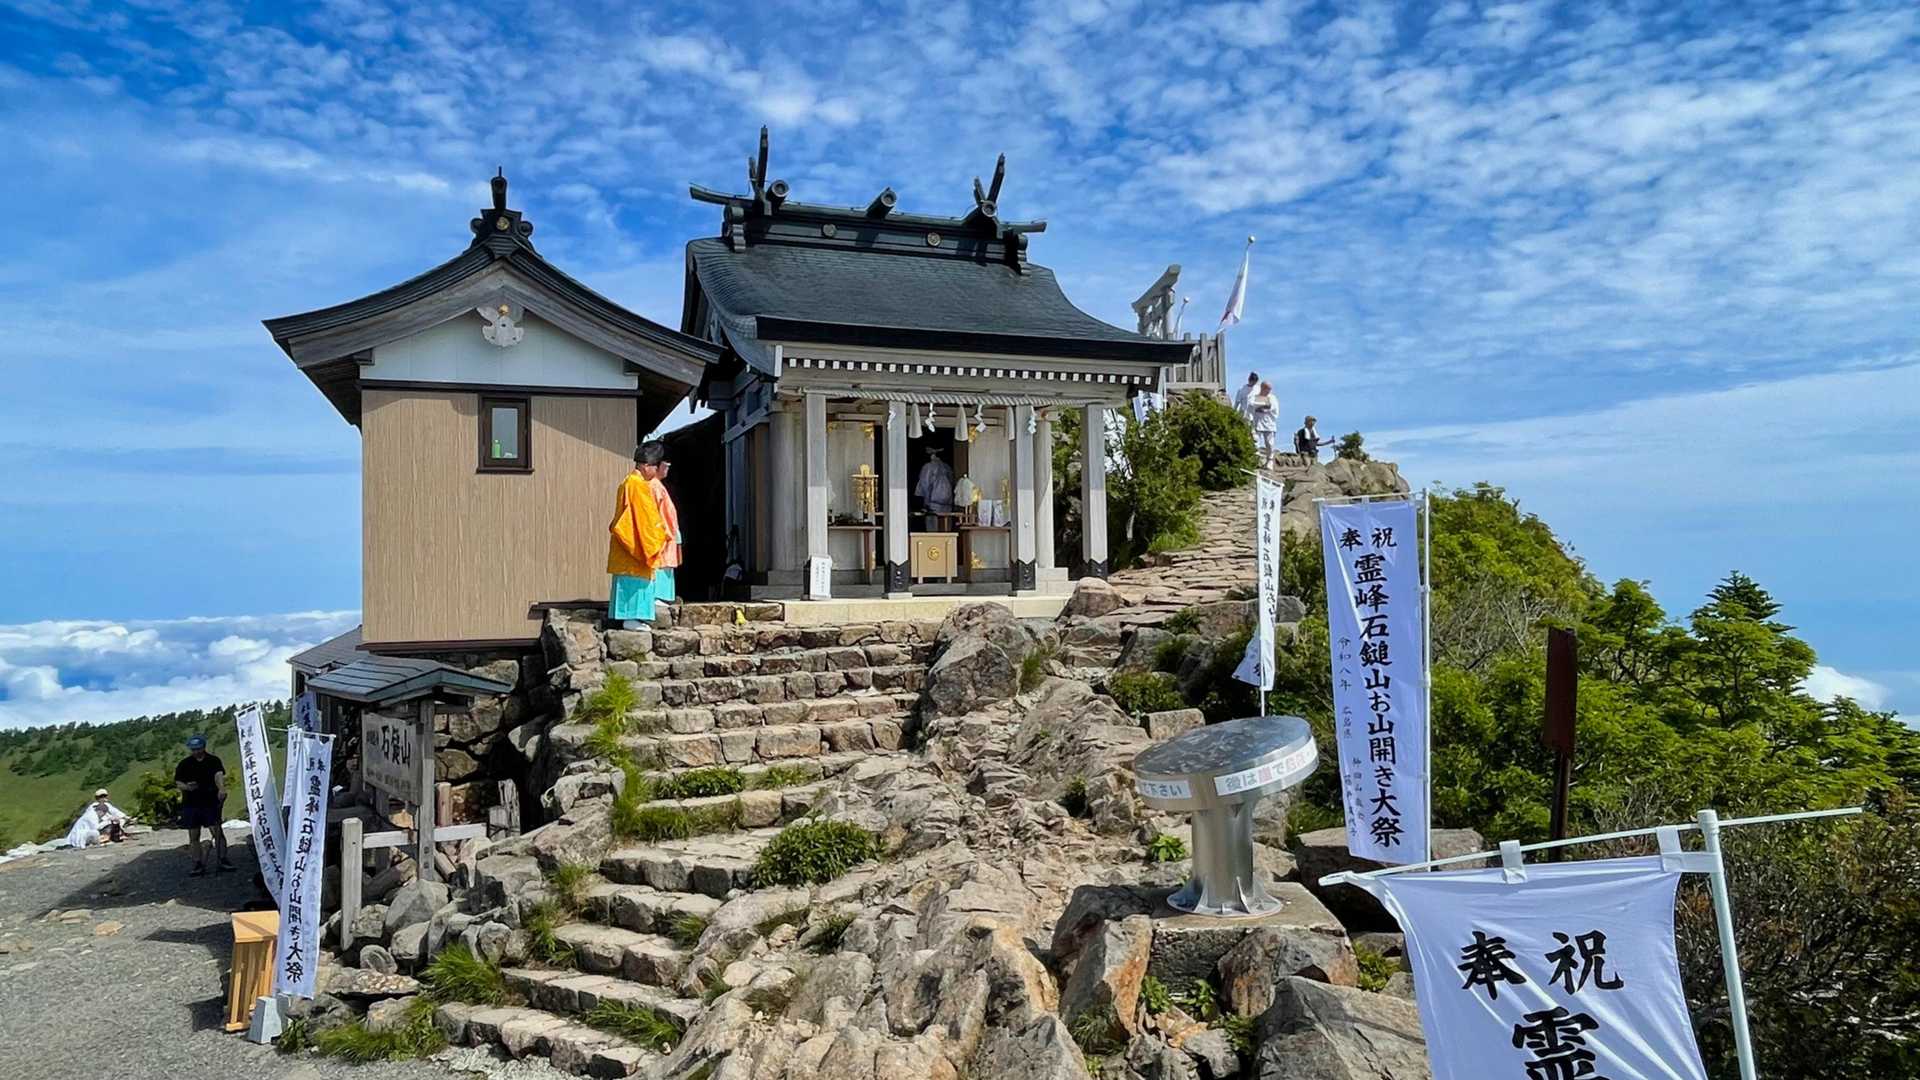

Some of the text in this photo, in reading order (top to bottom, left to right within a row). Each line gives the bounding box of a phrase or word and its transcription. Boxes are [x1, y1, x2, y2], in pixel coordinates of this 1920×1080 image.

[1340, 527, 1397, 552] 奉祝
[1338, 636, 1353, 692] 令和八年
[1354, 553, 1404, 847] 霊峰石鎚山お山開き大祭
[1457, 929, 1625, 1000] 奉祝
[1511, 1006, 1611, 1080] 霊
